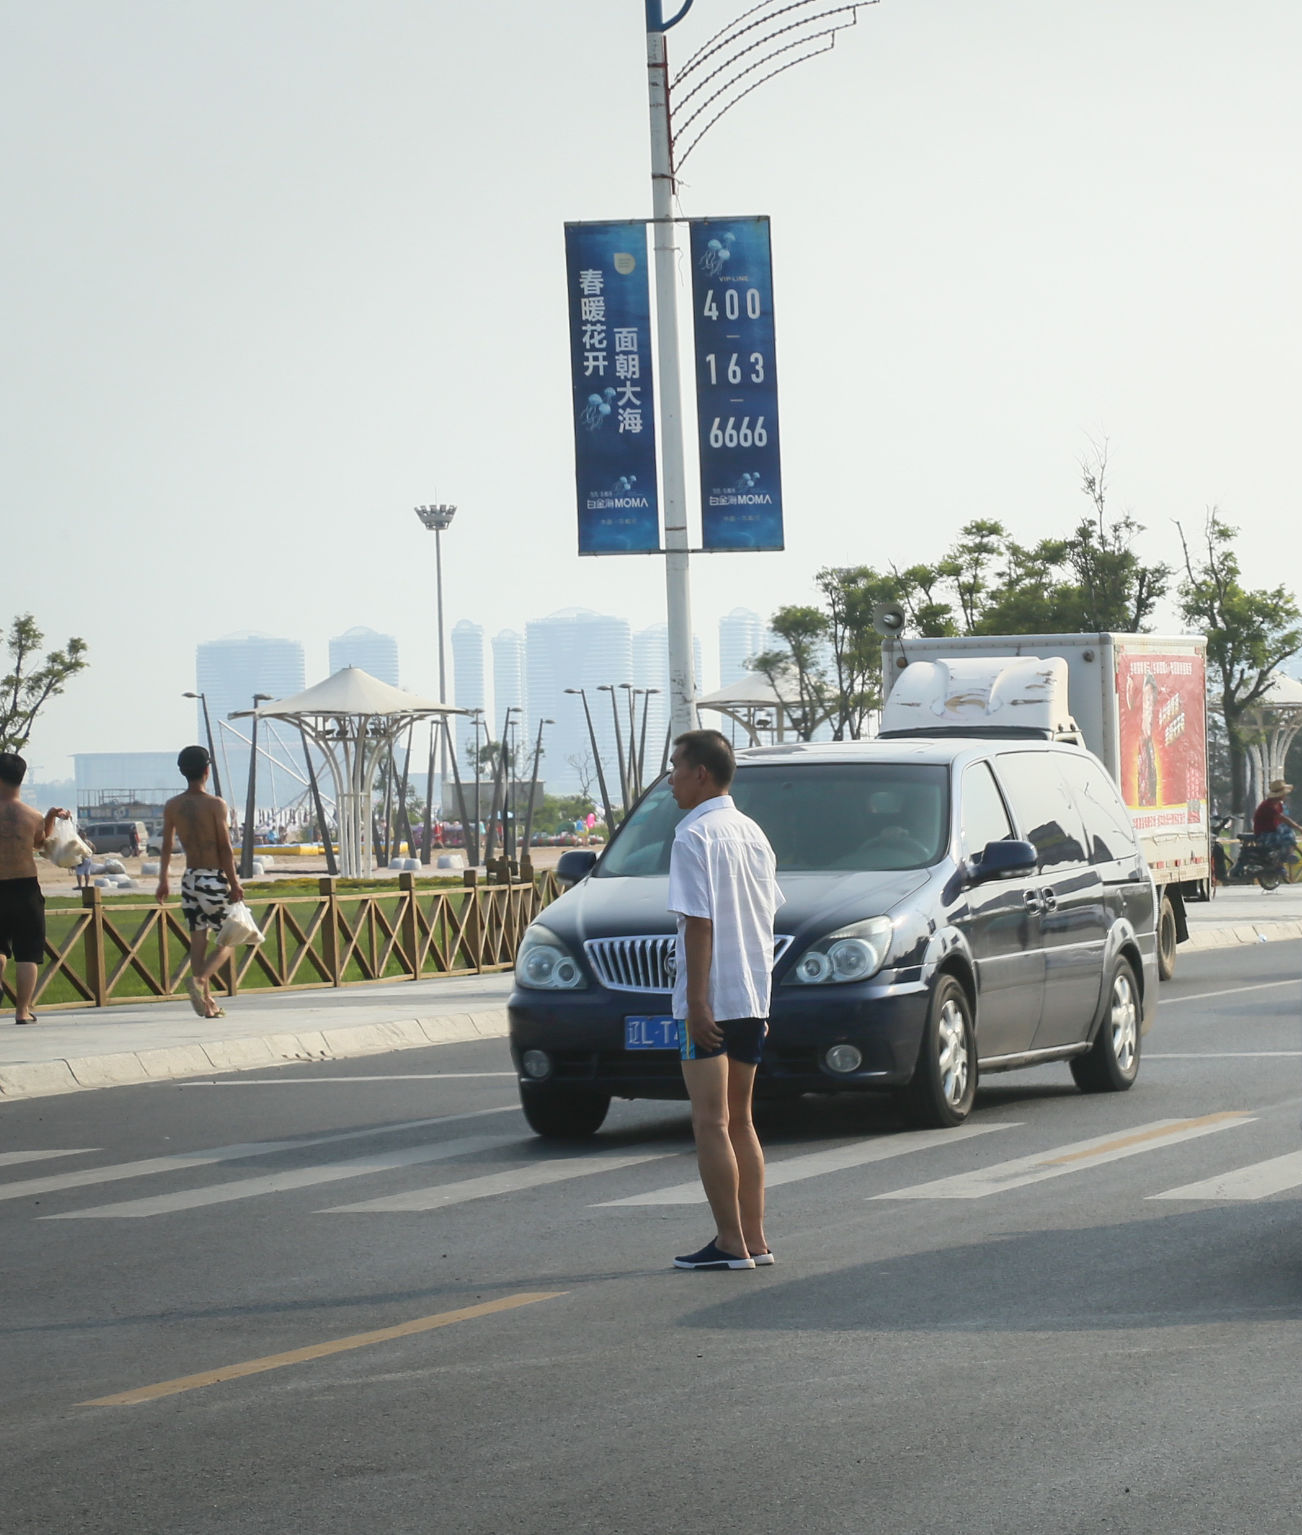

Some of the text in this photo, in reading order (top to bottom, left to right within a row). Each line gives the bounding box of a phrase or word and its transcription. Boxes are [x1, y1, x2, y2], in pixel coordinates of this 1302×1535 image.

[703, 289, 761, 320] 400
[579, 269, 608, 377] 春暖花开
[613, 327, 643, 434] 面朝大海
[705, 353, 765, 385] 163
[709, 416, 767, 448] 6666
